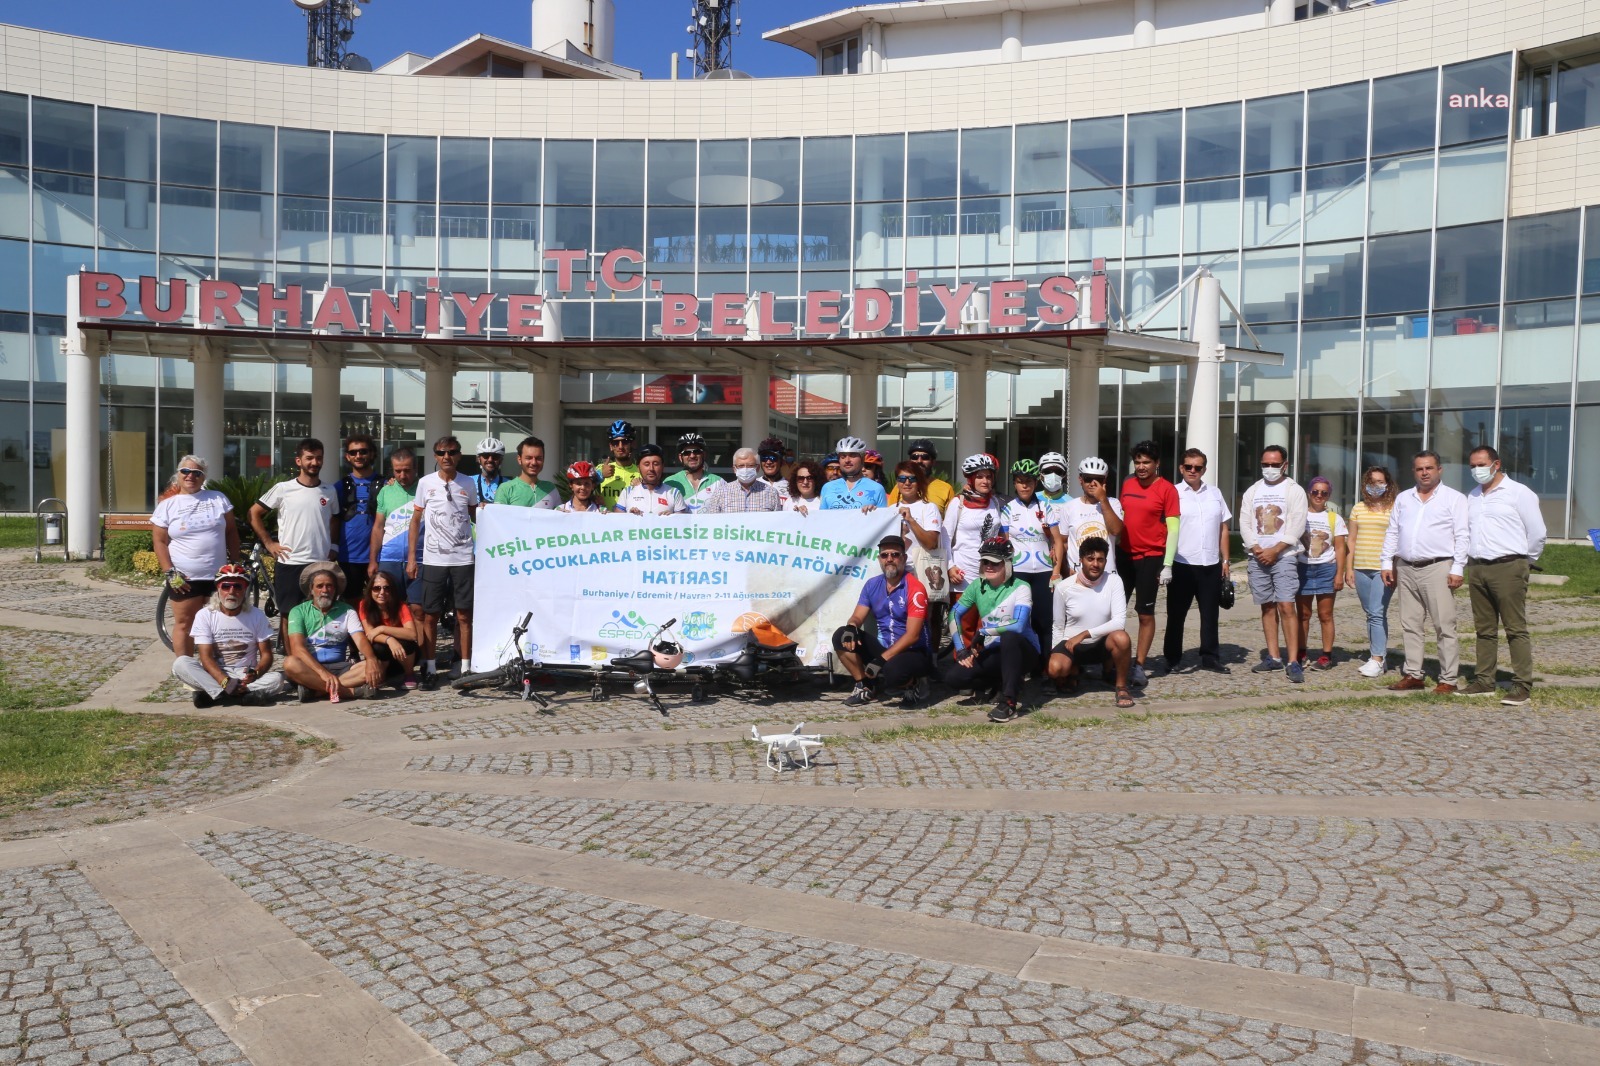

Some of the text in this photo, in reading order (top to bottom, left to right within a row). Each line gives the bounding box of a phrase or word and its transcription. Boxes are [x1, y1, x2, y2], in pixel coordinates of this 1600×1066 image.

[544, 247, 662, 292] T.C.
[79, 257, 1108, 338] BURHANİYE BELEDİYESİ
[485, 536, 532, 558] YEŞİL
[535, 529, 624, 550] PEDALLAR
[628, 523, 709, 541] ENGELSİZ
[713, 524, 832, 553] BİSİKLETLİLER
[508, 544, 868, 580] & ÇOCUKLARLA BİSİKLET ve SANAT ATÖLYESİ
[582, 588, 629, 599] Burhaniye
[630, 590, 636, 599] /
[636, 591, 672, 600] Edremit
[673, 591, 679, 600] /
[732, 591, 769, 601] Ağustos
[771, 591, 791, 599] 2021
